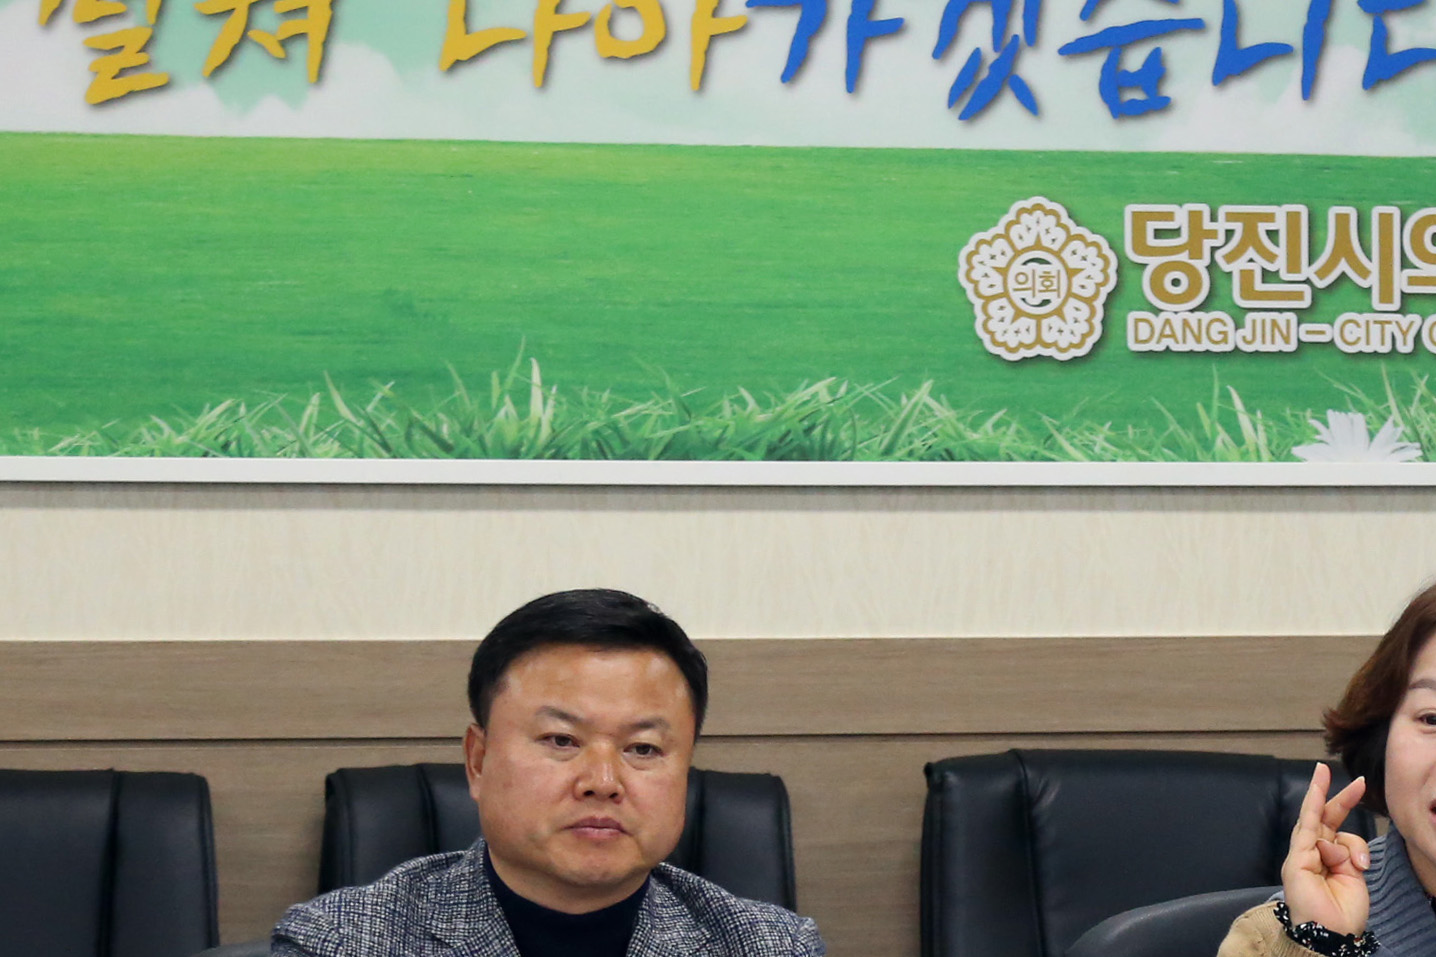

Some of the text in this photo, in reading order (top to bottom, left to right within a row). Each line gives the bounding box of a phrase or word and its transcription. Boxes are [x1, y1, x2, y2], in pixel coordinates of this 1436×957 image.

[1011, 267, 1063, 299] 의회
[1133, 318, 1229, 347] DANG
[1339, 320, 1416, 347] CITY
